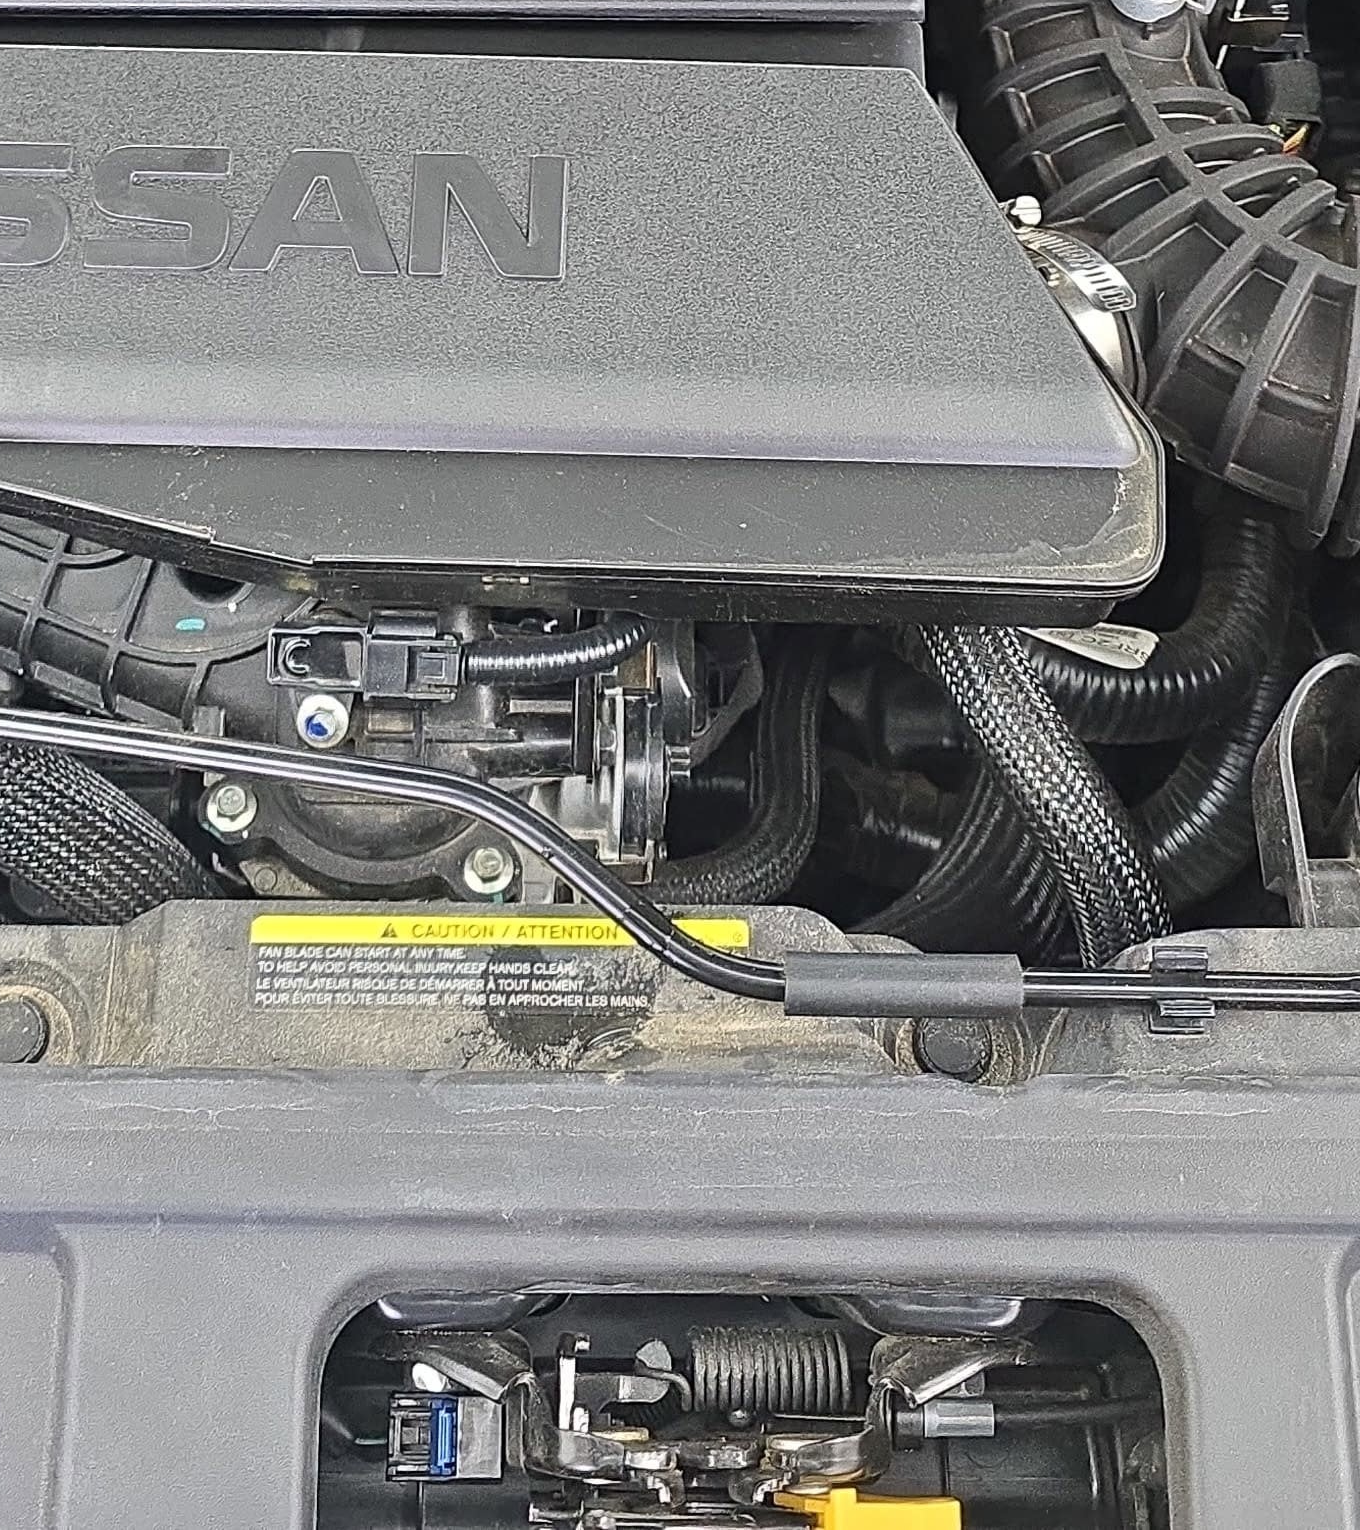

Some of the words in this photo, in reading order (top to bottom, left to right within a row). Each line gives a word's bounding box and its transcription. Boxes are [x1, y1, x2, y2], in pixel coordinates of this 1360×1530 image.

[412, 924, 495, 939] CAUTION
[516, 924, 619, 940] ATTENTION
[258, 946, 282, 958] FAN
[284, 946, 324, 958] BLADE
[325, 946, 352, 958] CAN
[354, 946, 391, 959] START
[393, 947, 407, 959] AT
[410, 947, 434, 959] ANY
[257, 961, 275, 973] TO
[277, 961, 308, 973] HELP
[310, 961, 346, 973] AVOID
[348, 961, 412, 974] PERSONAL
[488, 963, 531, 975] HANDS
[256, 977, 272, 990] LE
[273, 977, 350, 991] VENTILATEUR
[352, 978, 398, 990] RISQUE
[400, 979, 416, 991] DE
[418, 976, 484, 991] DÉMARRER
[486, 977, 496, 991] À
[497, 979, 530, 991] TOUT
[254, 992, 290, 1005] POUR
[292, 990, 332, 1005] ÉVITER
[334, 992, 374, 1005] TOUTE
[443, 993, 460, 1006] NE
[462, 994, 487, 1006] PAS
[489, 994, 506, 1006] EN
[507, 994, 583, 1007] APPROCHER
[586, 995, 608, 1007] LES
